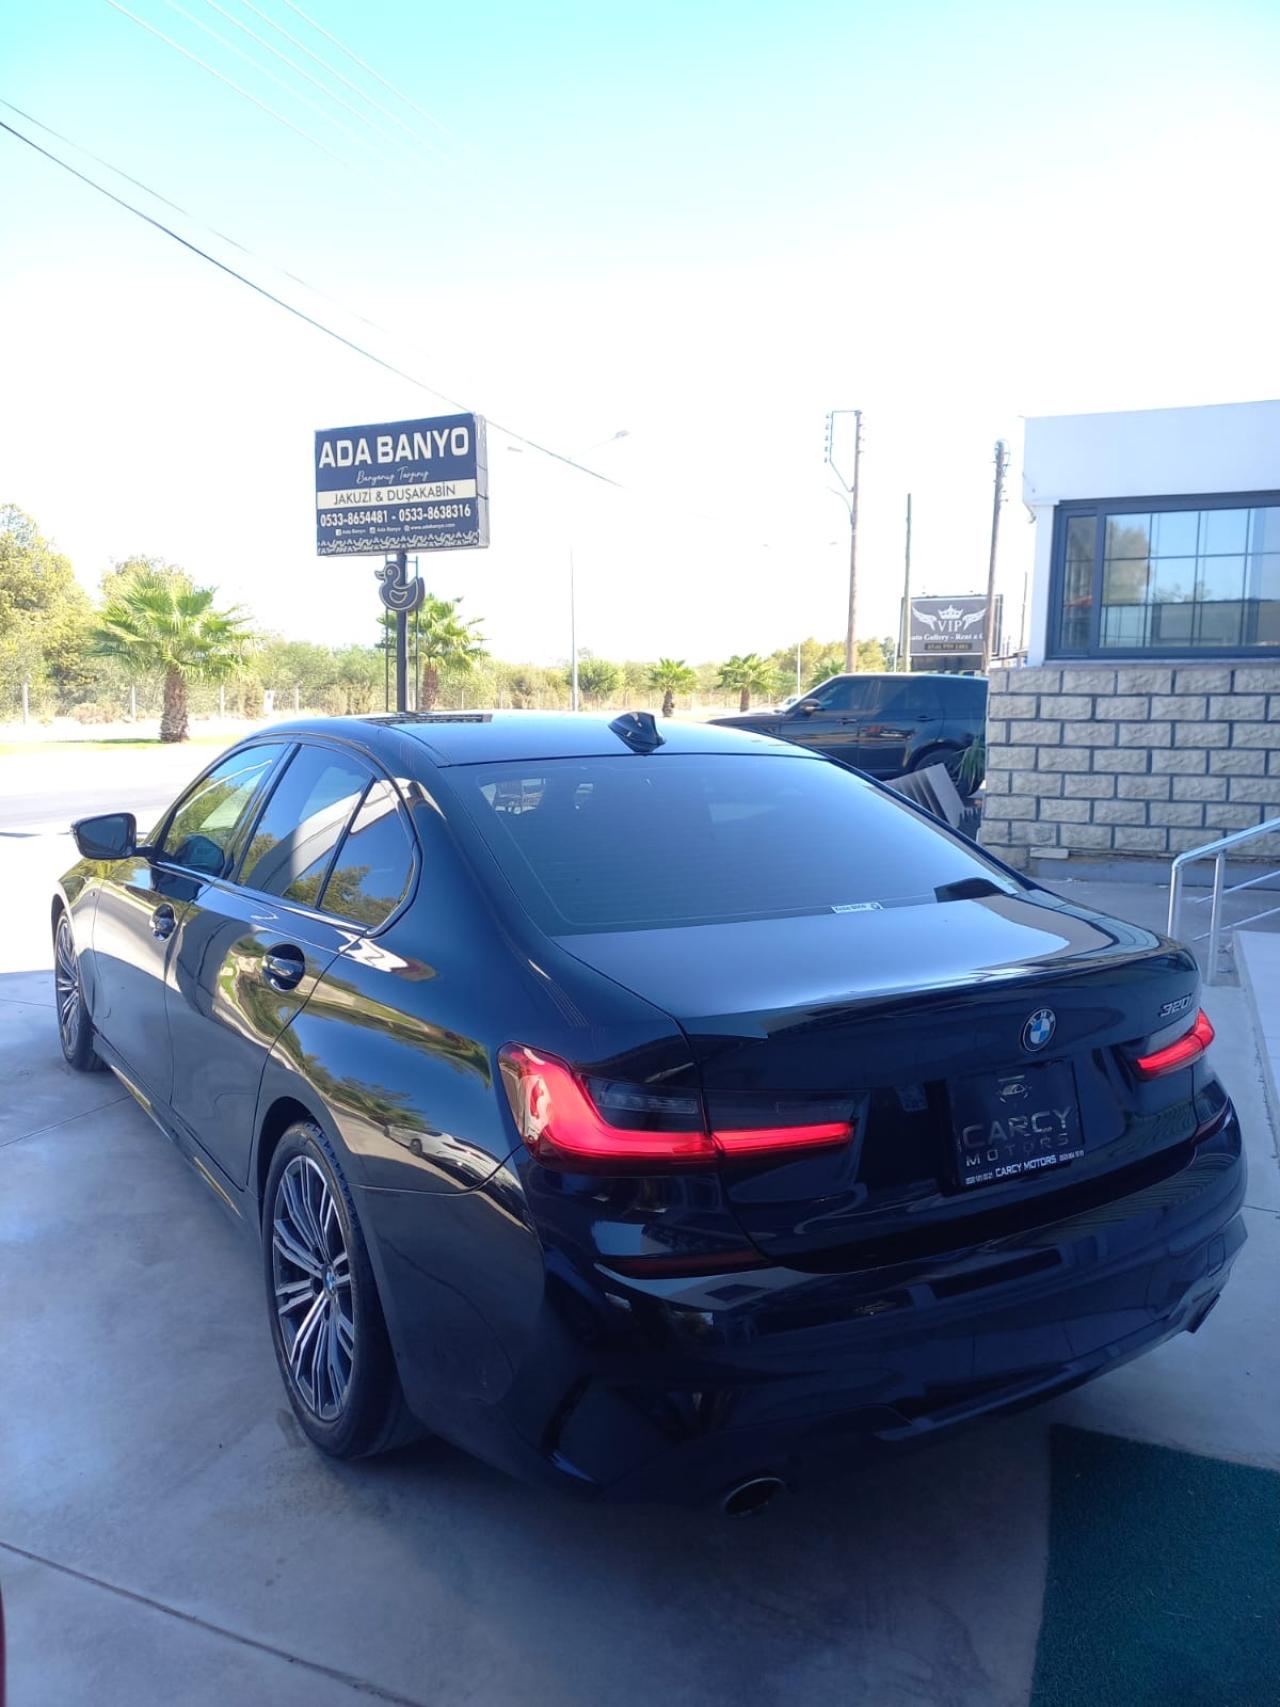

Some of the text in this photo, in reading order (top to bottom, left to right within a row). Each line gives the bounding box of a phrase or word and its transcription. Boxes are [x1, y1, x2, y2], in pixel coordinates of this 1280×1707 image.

[319, 427, 469, 469] ADA BANYO
[334, 482, 456, 505] JAKUZİ & DUŞAKABİN
[320, 510, 388, 527] 0533-8654481
[399, 504, 471, 522] 0533-8638316
[938, 620, 962, 632] VIP
[962, 1106, 1072, 1149] CARCY
[966, 1132, 1069, 1167] MOTORS
[995, 1163, 1021, 1178] CARCY
[1023, 1154, 1056, 1171] MOTORS
